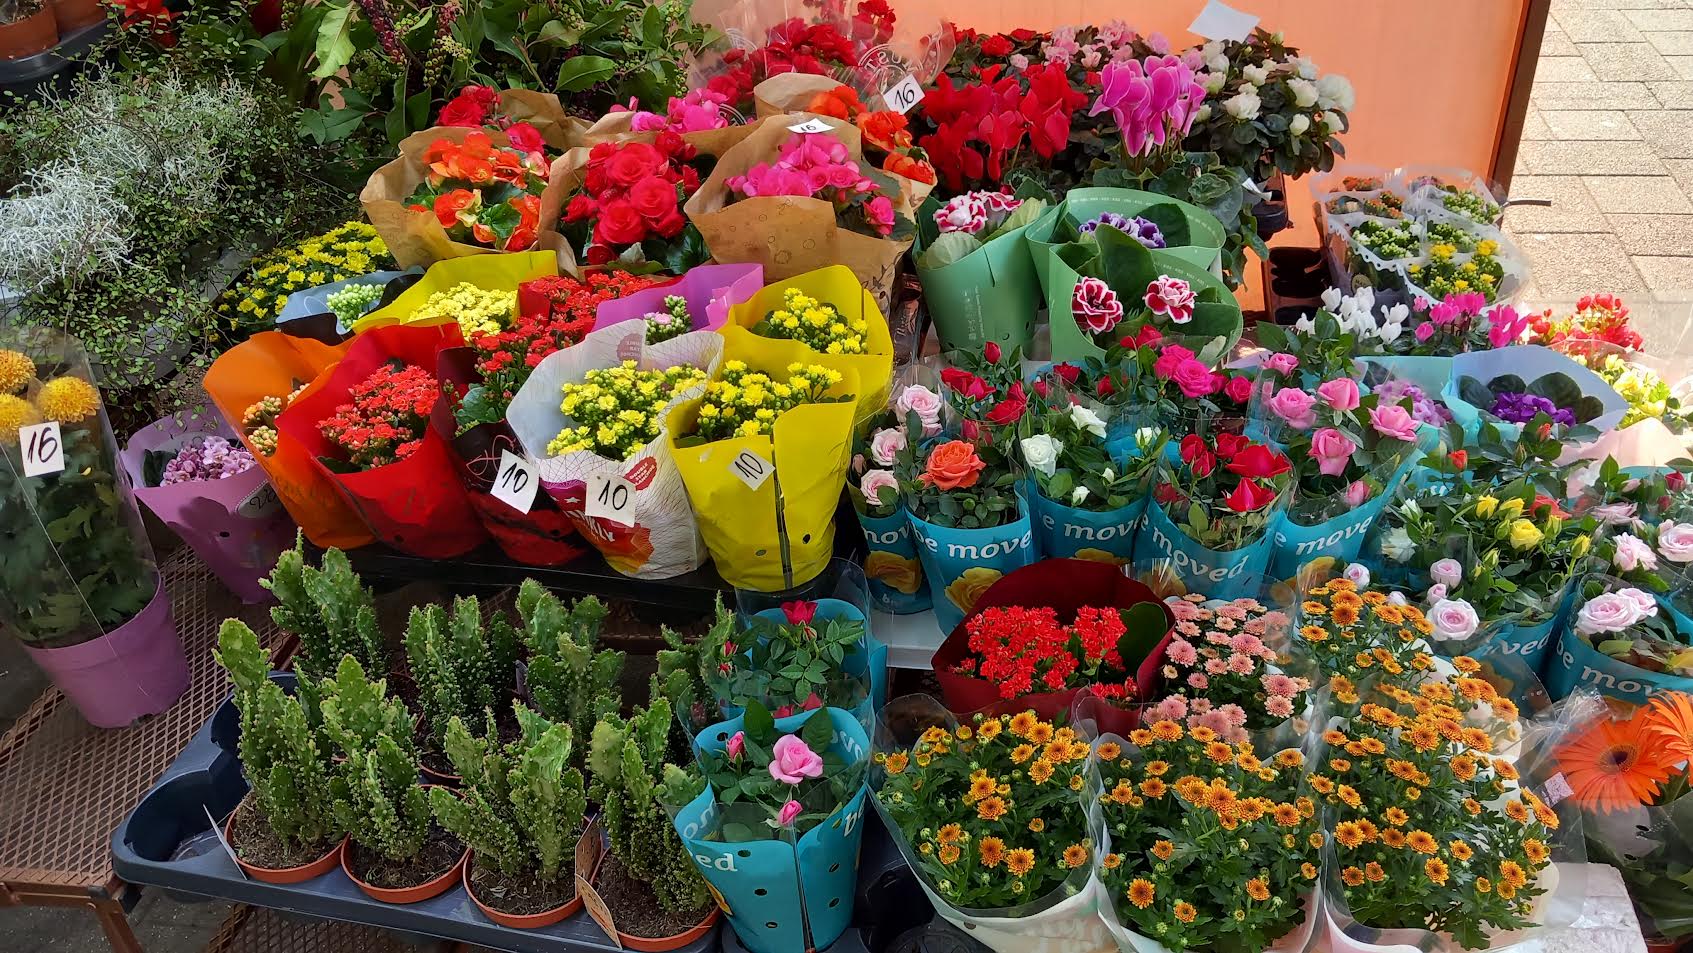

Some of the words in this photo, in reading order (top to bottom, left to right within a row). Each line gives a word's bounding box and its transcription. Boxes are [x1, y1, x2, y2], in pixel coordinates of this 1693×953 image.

[894, 82, 915, 109] 16
[800, 124, 817, 132] 16
[27, 426, 58, 464] 16
[502, 462, 529, 494] 10
[734, 452, 763, 480] 10
[598, 479, 628, 511] 10
[910, 520, 938, 553] be
[947, 529, 1032, 560] move
[1140, 513, 1149, 532] e
[1152, 525, 1249, 583] moved
[1274, 531, 1287, 548] e
[1295, 515, 1374, 556] move
[1556, 630, 1576, 671] be
[689, 849, 739, 873] ed
